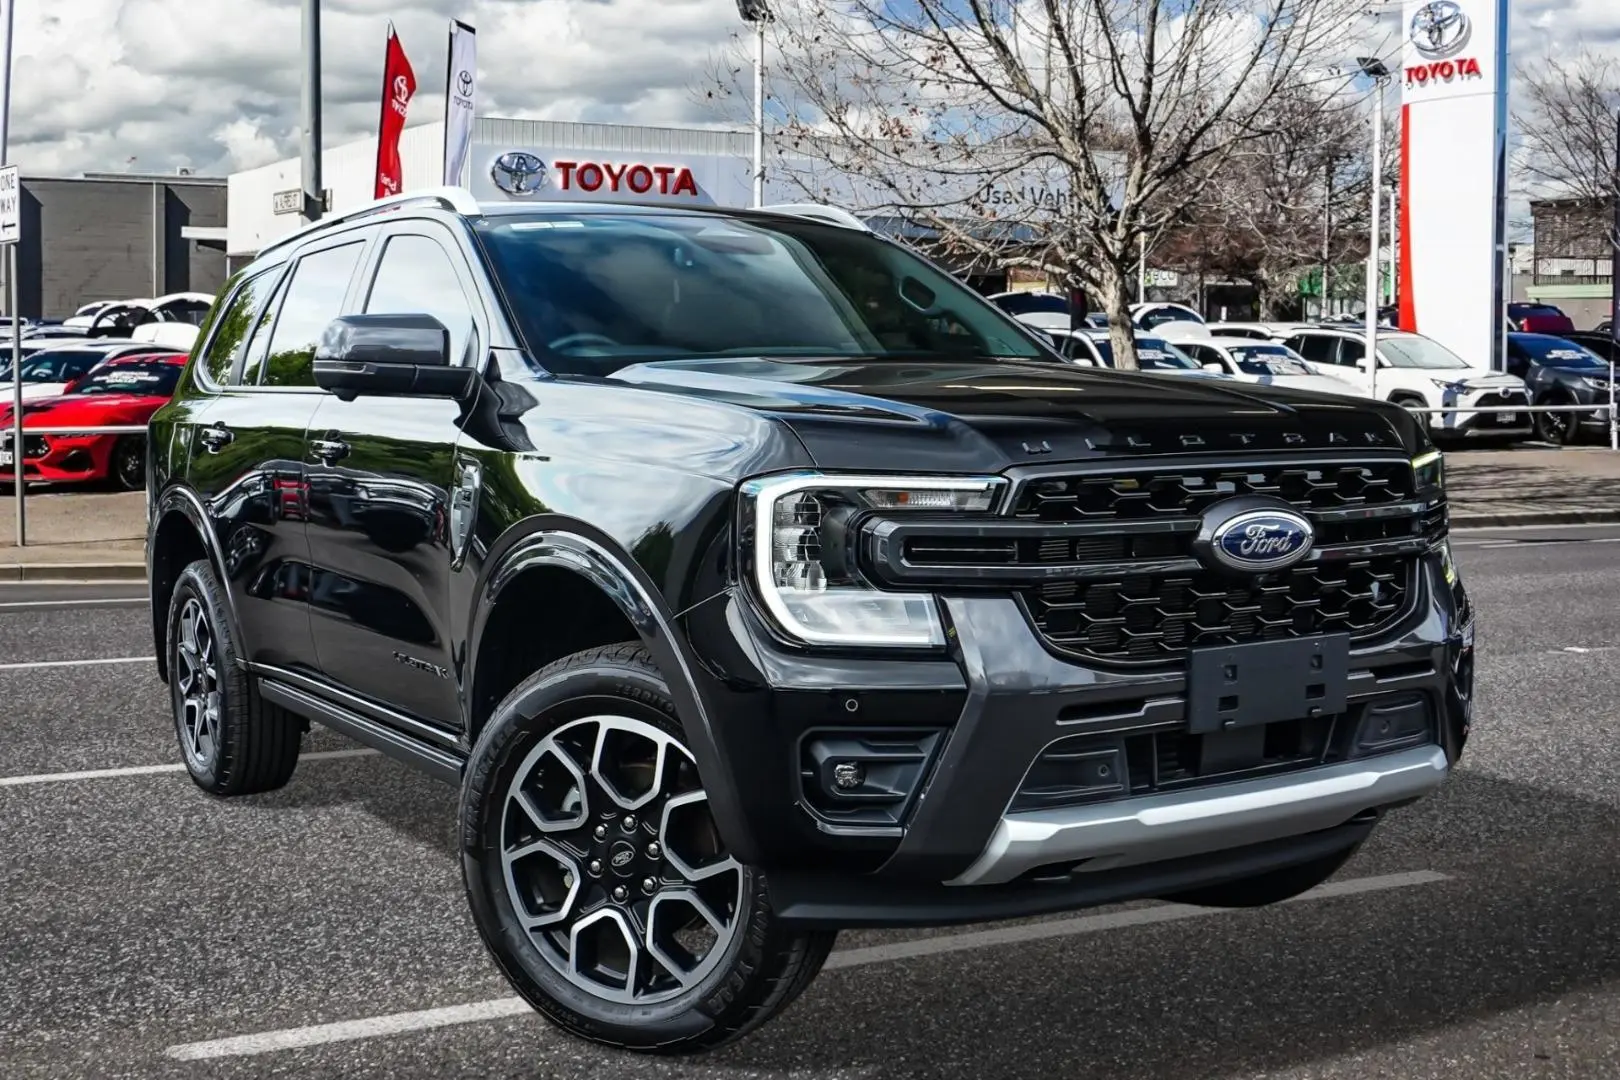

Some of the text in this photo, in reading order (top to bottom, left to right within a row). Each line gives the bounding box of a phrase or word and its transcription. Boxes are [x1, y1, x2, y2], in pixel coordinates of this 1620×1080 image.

[1404, 58, 1481, 84] TOYOTA
[0, 172, 15, 192] ONE
[555, 161, 698, 196] TOYOTA
[0, 195, 16, 214] WAY
[1240, 524, 1293, 555] Ford
